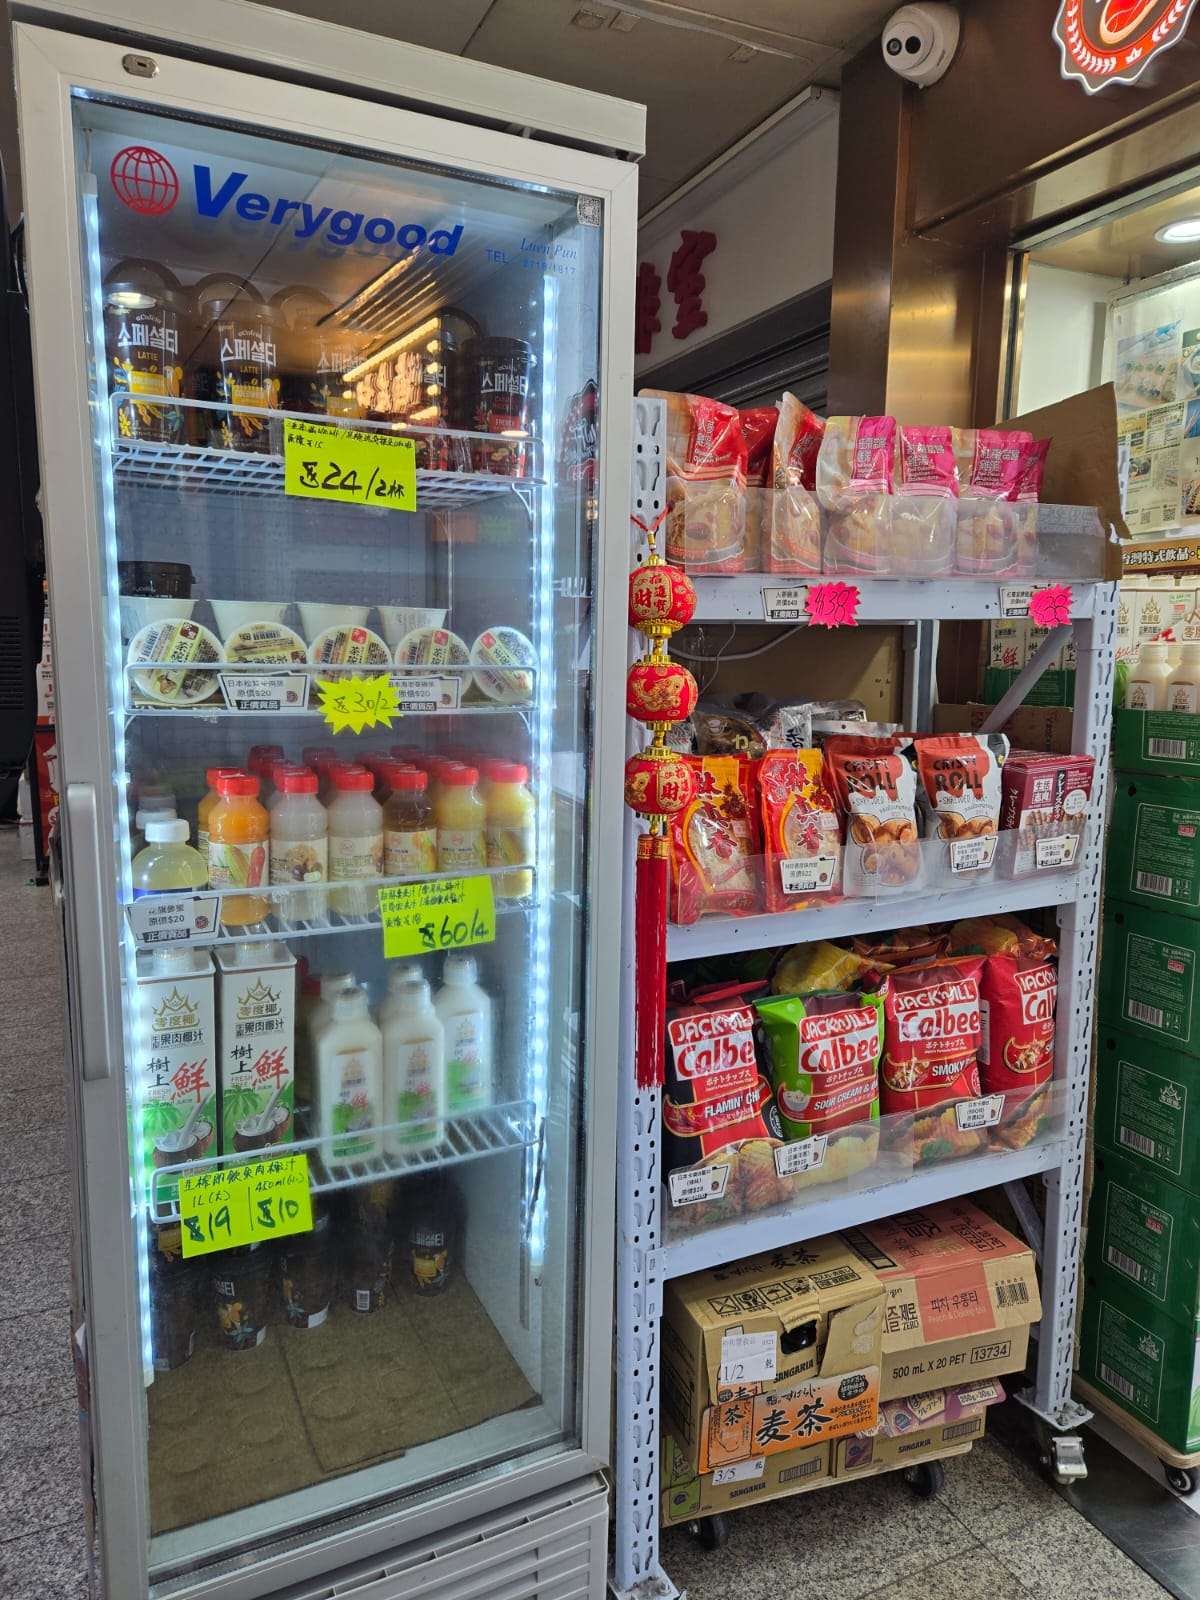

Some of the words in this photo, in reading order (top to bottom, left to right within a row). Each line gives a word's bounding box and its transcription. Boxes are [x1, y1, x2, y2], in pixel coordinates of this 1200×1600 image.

[193, 163, 465, 257] Verygood
[485, 248, 509, 265] TEL
[137, 350, 159, 361] LATTE
[220, 337, 277, 367] 스페셜티
[239, 365, 259, 375] LATTE
[236, 689, 272, 698] 原價$20
[846, 771, 896, 793] ROLL
[934, 771, 982, 792] ROLL
[148, 915, 185, 926] 原價$20
[240, 1003, 278, 1016] 零度椰
[1025, 985, 1056, 1022] Cal
[154, 1013, 196, 1027] 零度椰
[902, 1009, 980, 1039] Calbee
[800, 1034, 879, 1073] Calbee
[251, 1045, 289, 1090] 鮮
[931, 1060, 964, 1077] SMOKY
[169, 1058, 211, 1104] 鮮
[704, 1095, 744, 1119] FLAMIN'
[814, 1096, 837, 1111] SOUR
[837, 1088, 862, 1105] CREAM
[257, 1197, 299, 1228] $10
[900, 1303, 918, 1323] 제로
[931, 1298, 949, 1313] 피치
[953, 1290, 979, 1309] 우롱티
[902, 1321, 919, 1331] ZERO
[722, 1363, 745, 1383] 1/2
[773, 1359, 814, 1384] SANGARIA
[892, 1366, 910, 1380] 500
[912, 1362, 926, 1377] mL
[927, 1360, 935, 1371] X
[936, 1357, 947, 1370] 20
[949, 1352, 967, 1367] PET
[974, 1344, 1008, 1360] 13734
[724, 1404, 746, 1427] 茶
[756, 1397, 834, 1448] 麦茶
[714, 1467, 737, 1483] 3/5
